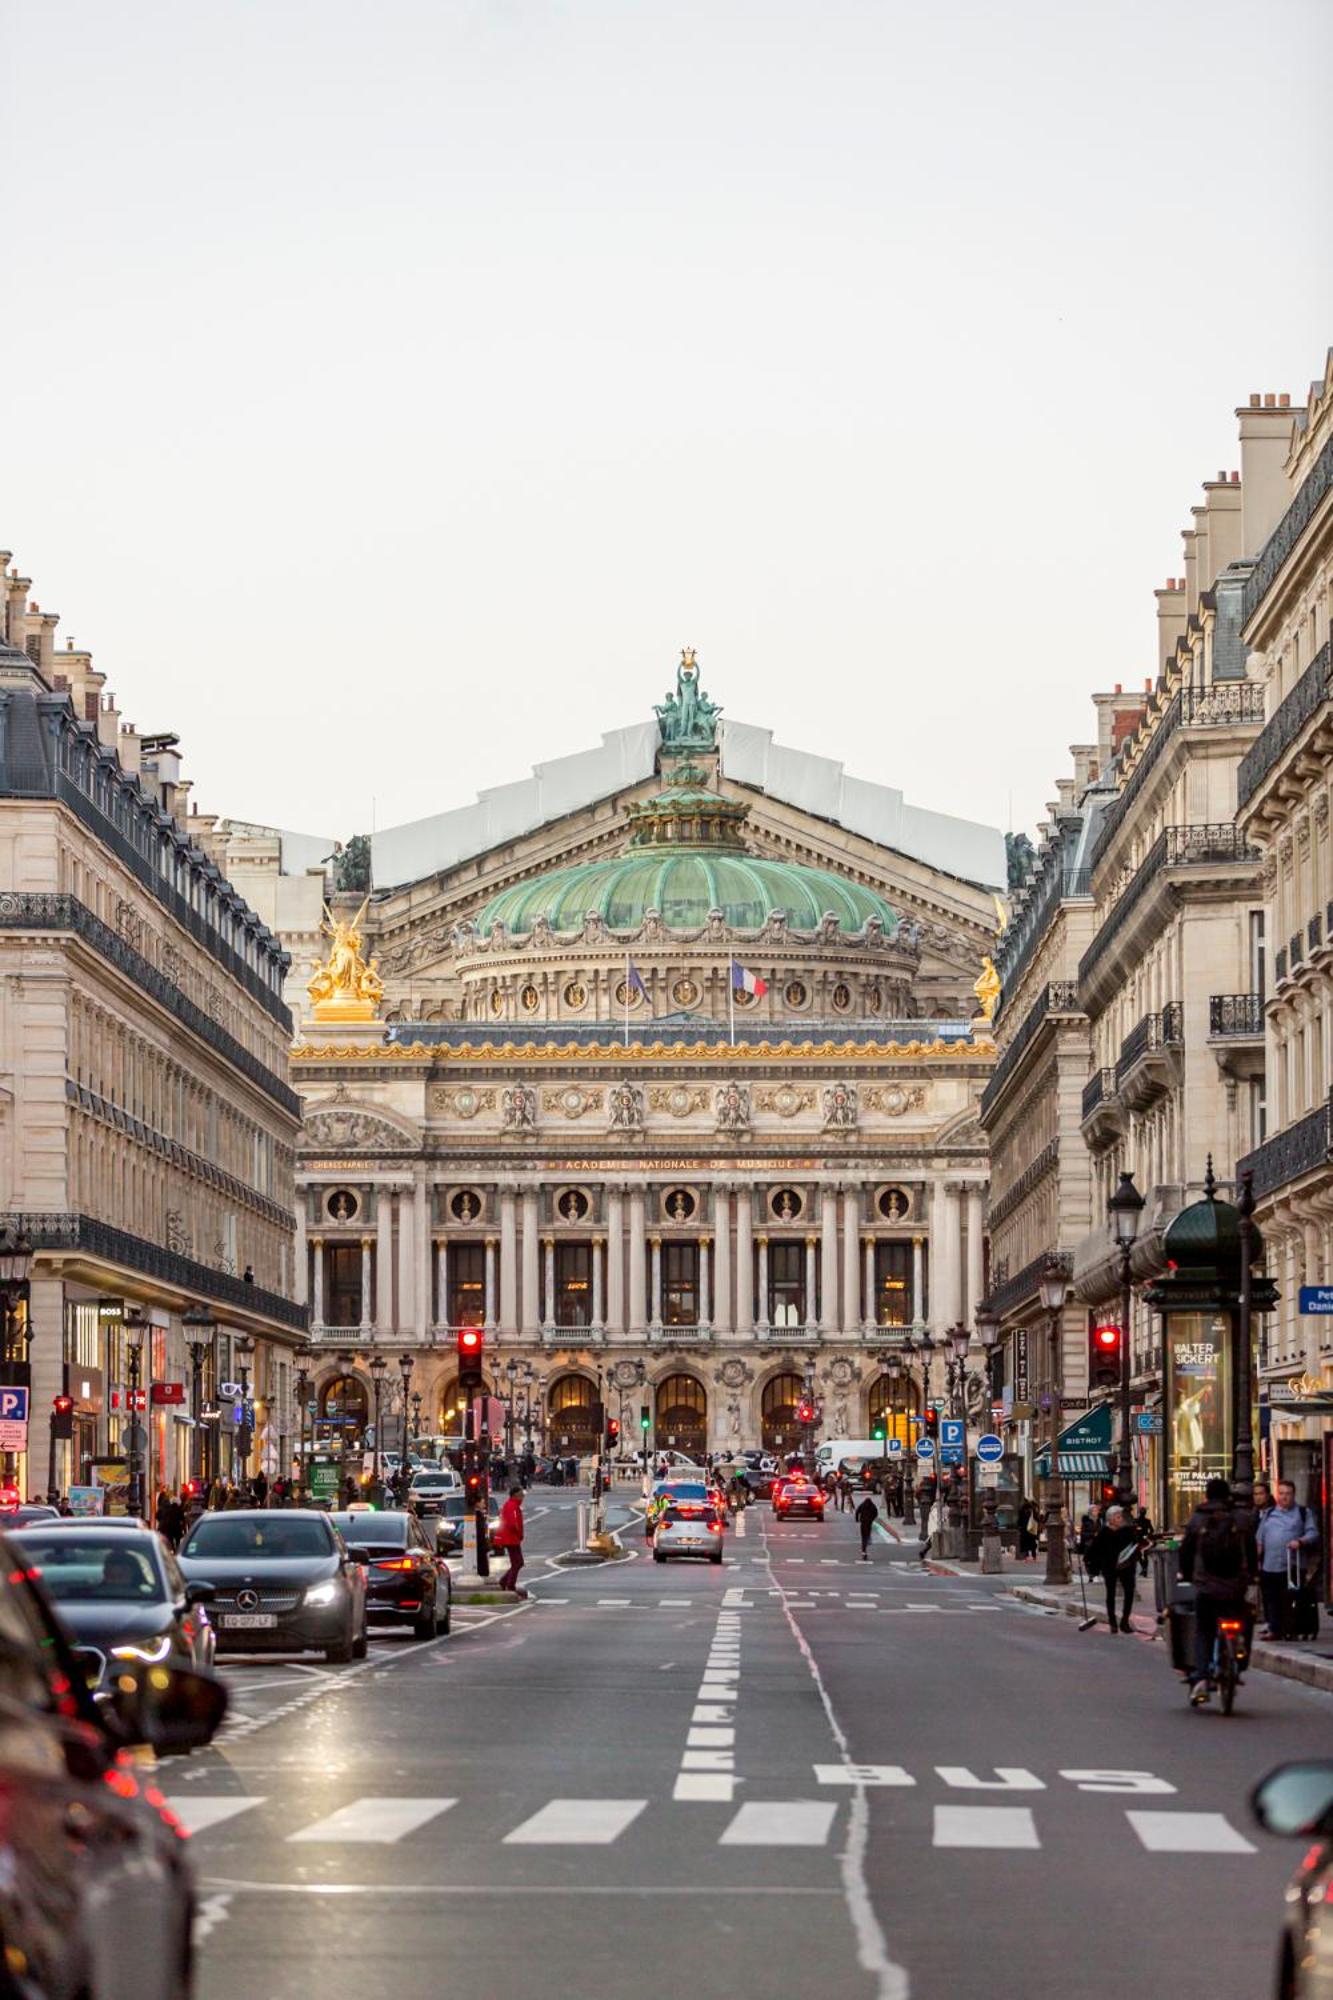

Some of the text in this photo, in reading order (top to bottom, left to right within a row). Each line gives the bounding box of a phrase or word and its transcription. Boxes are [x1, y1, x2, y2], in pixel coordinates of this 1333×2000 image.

[639, 1160, 699, 1169] NATIONALE
[710, 1160, 726, 1169] DE
[100, 1307, 121, 1316] BOSS
[1174, 1343, 1214, 1354] WALTER
[1176, 1353, 1220, 1365] SICKERT
[2, 1394, 18, 1416] P
[948, 1426, 959, 1441] P
[892, 1441, 899, 1451] P
[1066, 1437, 1102, 1445] BISTROT
[812, 1764, 1178, 1794] BUS
